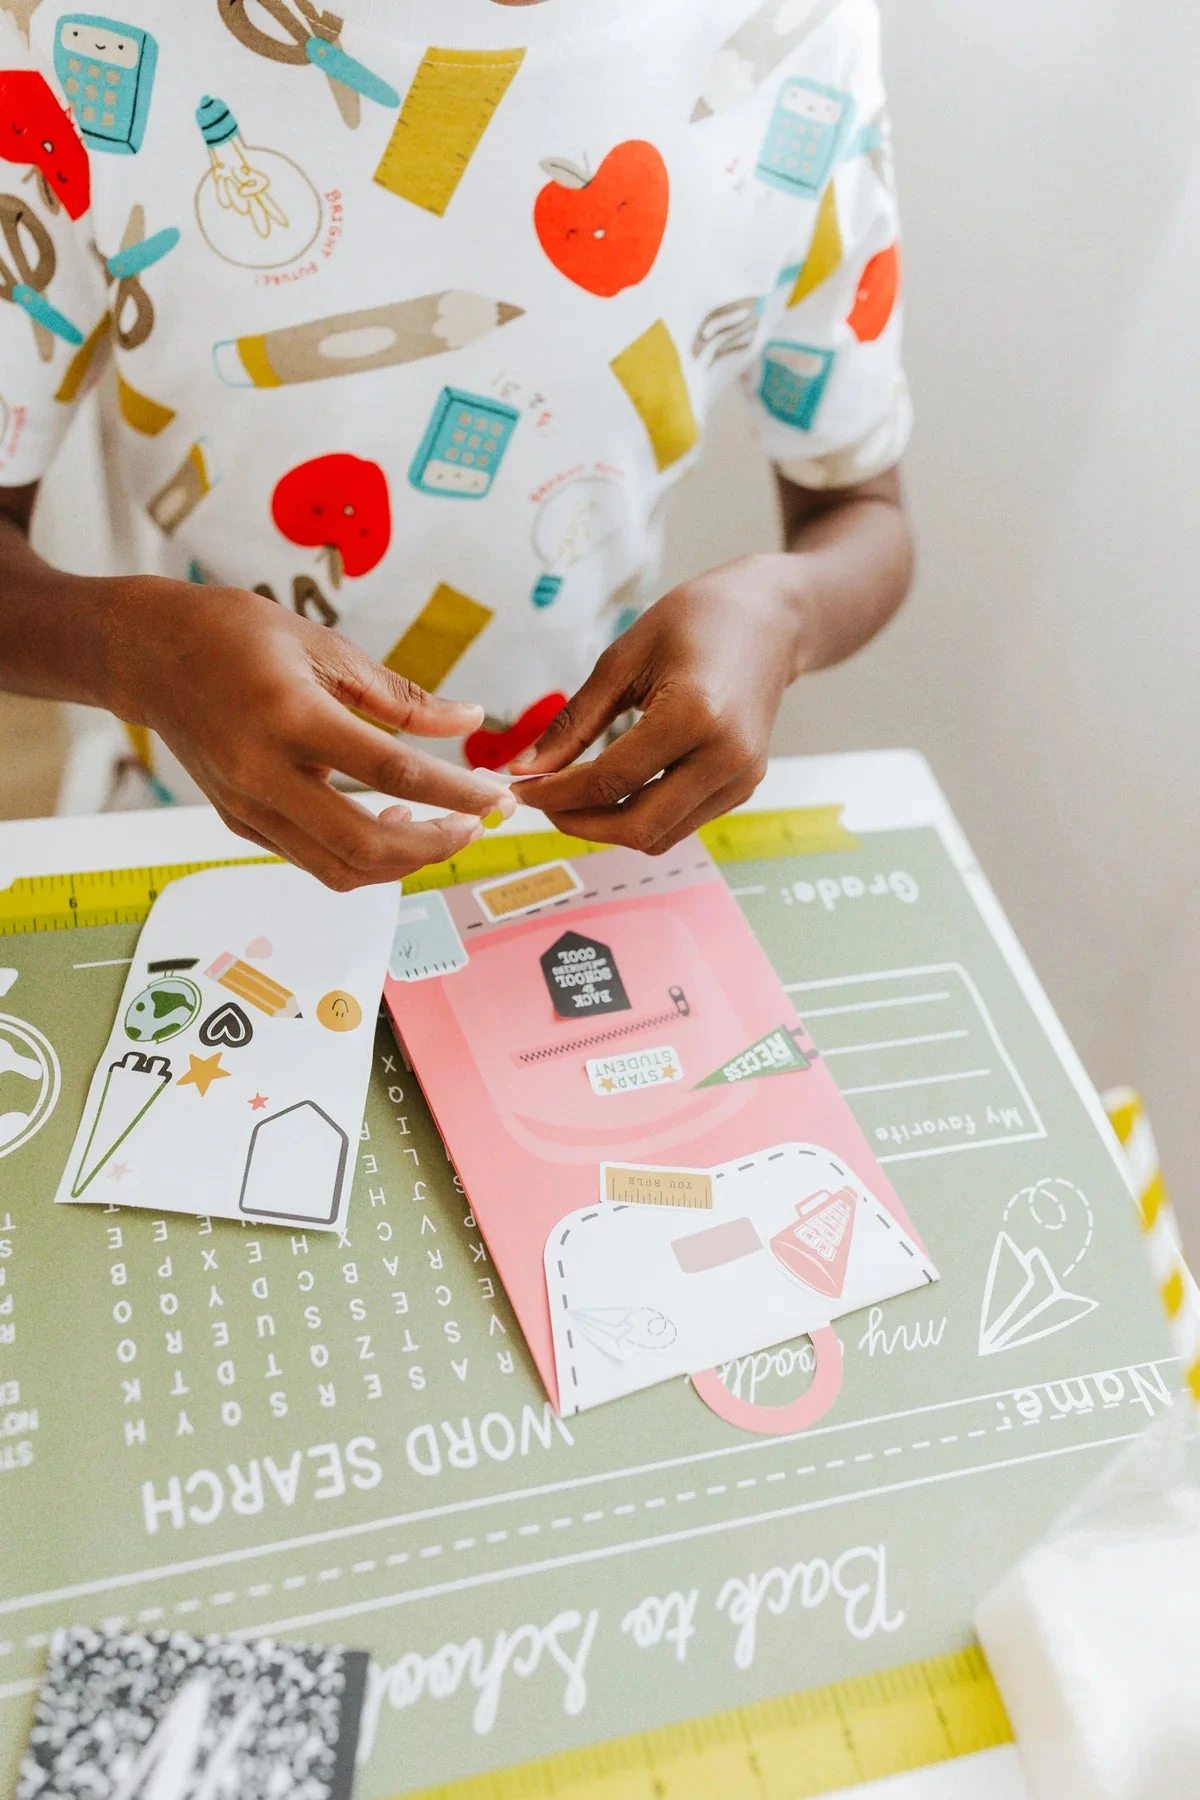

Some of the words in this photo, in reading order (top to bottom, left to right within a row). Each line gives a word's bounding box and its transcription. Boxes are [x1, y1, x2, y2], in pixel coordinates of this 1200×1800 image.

[782, 869, 919, 909] Grade:
[557, 946, 597, 965] COOL
[554, 966, 613, 988] SCHOOL
[571, 989, 613, 1008] BACK
[382, 1056, 396, 1072] X
[594, 1049, 672, 1077] STUDENT
[722, 1031, 794, 1082] RECESS
[617, 1069, 659, 1089] STAR
[388, 1086, 404, 1103] Q
[397, 1117, 410, 1135] I
[873, 1110, 977, 1144] favorite
[984, 1104, 1025, 1131] My
[362, 1154, 378, 1174] E
[403, 1149, 419, 1166] L
[413, 1181, 426, 1201] J
[628, 1176, 661, 1188] RULE
[669, 1180, 693, 1190] YOU
[369, 1187, 386, 1207] H
[196, 1215, 212, 1235] E
[421, 1215, 436, 1235] V
[463, 1207, 476, 1227] P
[106, 1227, 124, 1250] E
[153, 1221, 168, 1242] E
[337, 1231, 351, 1248] X
[377, 1221, 393, 1241] C
[245, 1241, 263, 1263] E
[291, 1237, 309, 1255] H
[469, 1242, 486, 1262] K
[157, 1256, 173, 1278] P
[201, 1248, 218, 1271] X
[382, 1256, 398, 1276] A
[427, 1249, 444, 1270] R
[110, 1263, 128, 1286] B
[298, 1270, 315, 1292] C
[342, 1262, 358, 1284] B
[208, 1286, 224, 1308] Y
[251, 1277, 269, 1299] D
[435, 1285, 452, 1306] C
[479, 1277, 494, 1299] E
[112, 1300, 133, 1324] O
[159, 1293, 179, 1315] Q
[349, 1298, 366, 1321] S
[392, 1292, 409, 1314] E
[257, 1314, 275, 1337] U
[304, 1306, 321, 1329] S
[490, 1315, 504, 1335] V
[165, 1330, 183, 1354] R
[211, 1321, 229, 1347] E
[402, 1330, 418, 1352] T
[444, 1321, 461, 1343] S
[858, 1307, 947, 1357] my
[117, 1338, 137, 1363] O
[310, 1344, 329, 1367] Q
[356, 1335, 375, 1359] Z
[217, 1360, 235, 1386] D
[265, 1353, 283, 1378] T
[451, 1358, 468, 1381] A
[497, 1351, 514, 1373] R
[170, 1370, 190, 1396] T
[364, 1373, 382, 1399] E
[408, 1366, 426, 1390] S
[121, 1379, 141, 1404] K
[318, 1383, 336, 1407] R
[994, 1363, 1174, 1427] Name:
[269, 1391, 288, 1417] S
[124, 1419, 146, 1446] H
[176, 1411, 194, 1435] Y
[405, 1398, 574, 1477] WORD
[140, 1434, 382, 1534] SEARCH
[715, 1542, 905, 1670] Back
[620, 1588, 700, 1662] to
[354, 1607, 603, 1768] School
